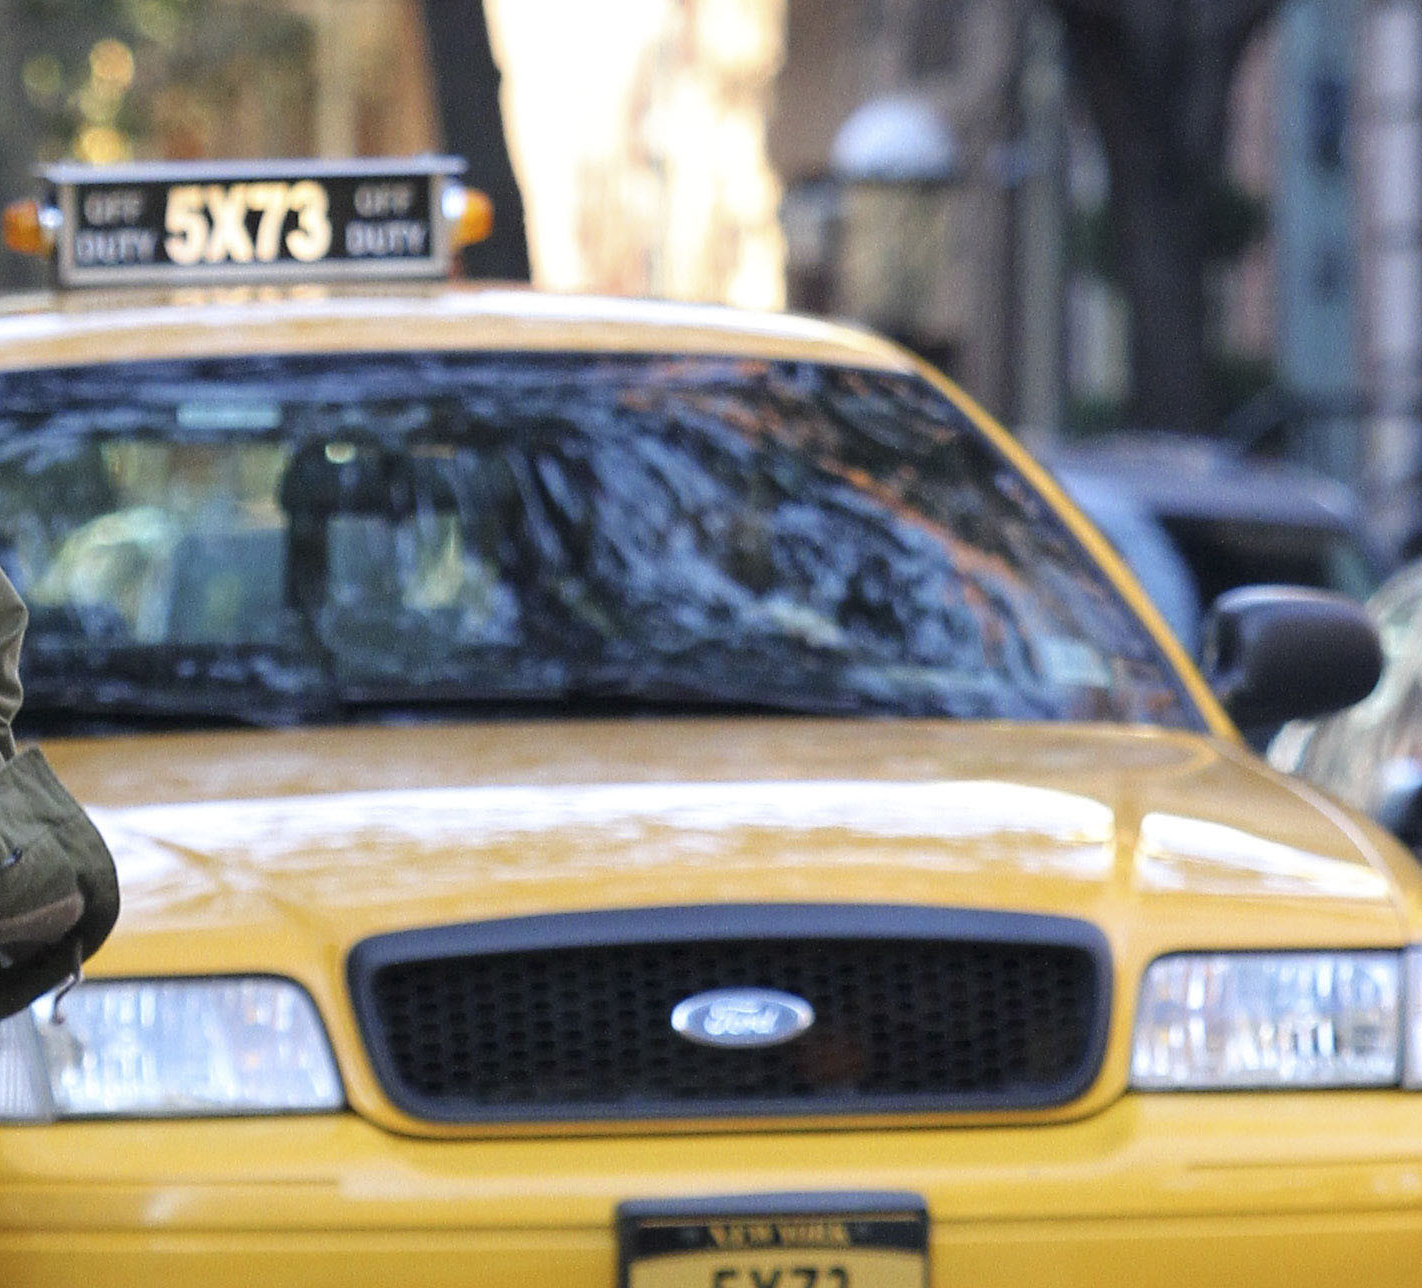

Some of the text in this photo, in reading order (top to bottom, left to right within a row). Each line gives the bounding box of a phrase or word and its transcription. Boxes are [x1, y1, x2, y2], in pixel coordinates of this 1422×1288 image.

[83, 191, 142, 226] OFF
[354, 183, 414, 218] OFF
[164, 180, 332, 266] 5X73
[345, 219, 426, 256] DUTY
[76, 229, 157, 264] DUTY
